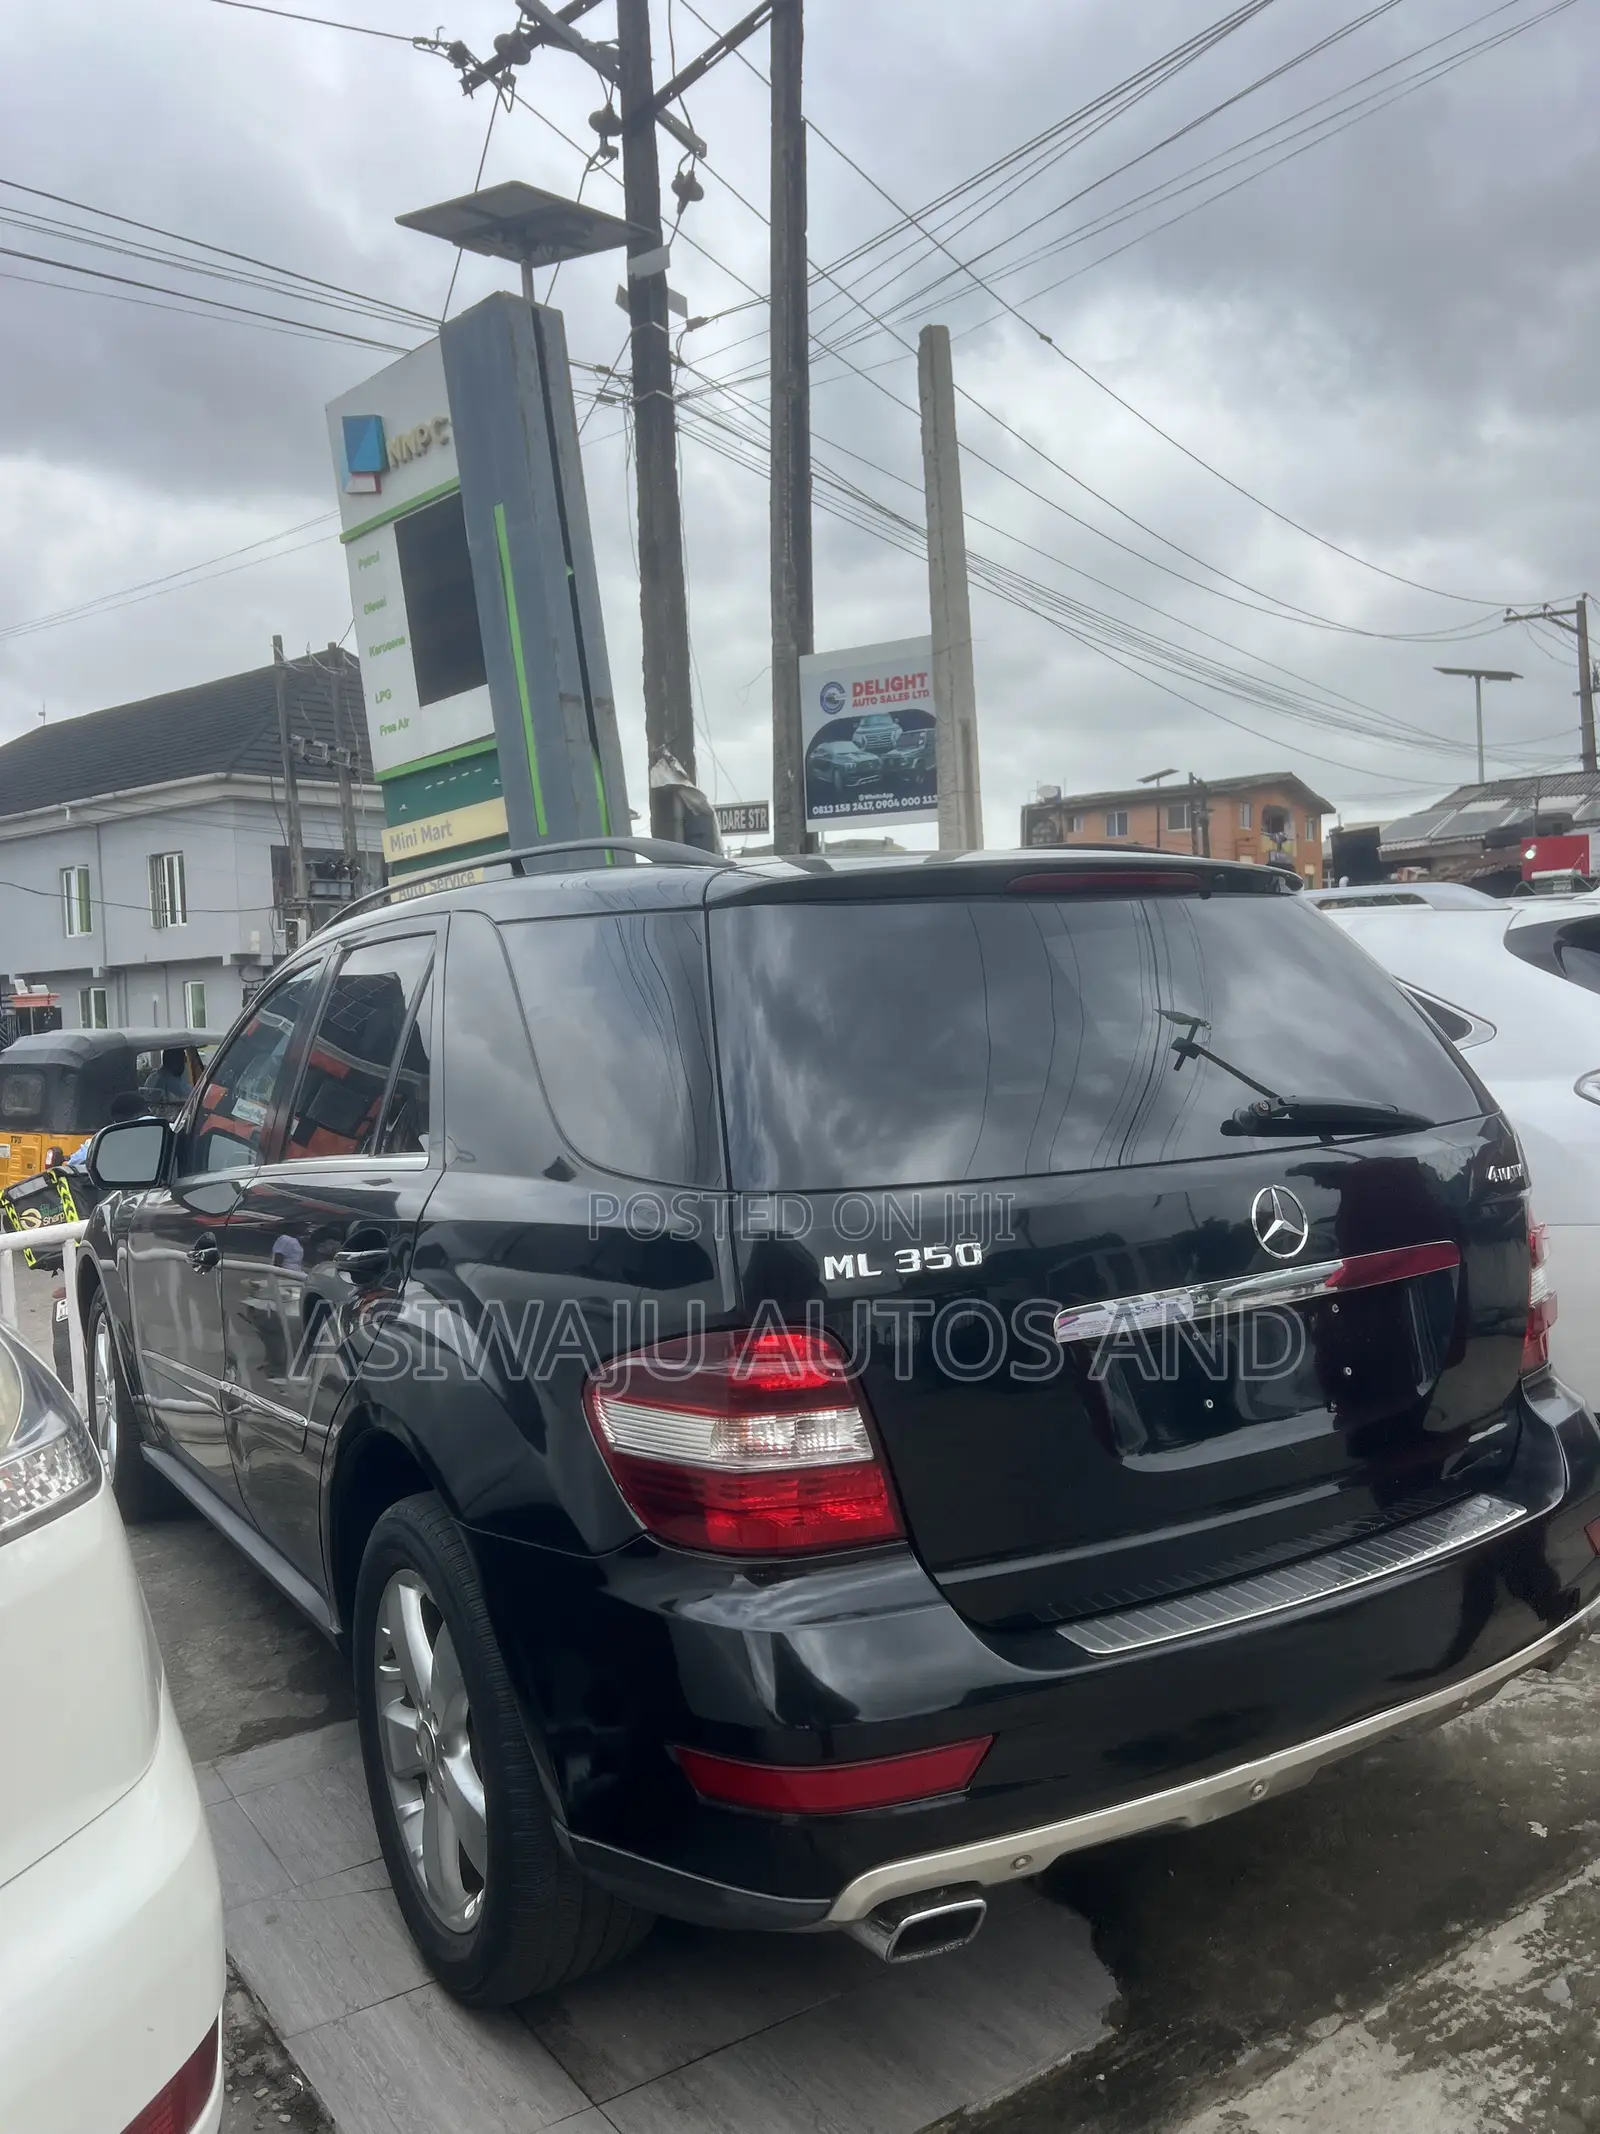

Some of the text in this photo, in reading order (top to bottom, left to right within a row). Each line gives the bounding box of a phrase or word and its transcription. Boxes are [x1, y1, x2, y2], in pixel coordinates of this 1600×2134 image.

[387, 416, 450, 469] NNPC
[375, 688, 391, 704] LPG
[852, 672, 928, 698] DELIGHT
[852, 689, 930, 708] AUTO SALES LTD
[380, 724, 397, 737] Free
[748, 808, 767, 829] STR
[389, 820, 453, 852] Mini Mart
[428, 869, 476, 894] Service
[823, 1242, 983, 1281] ML 350
